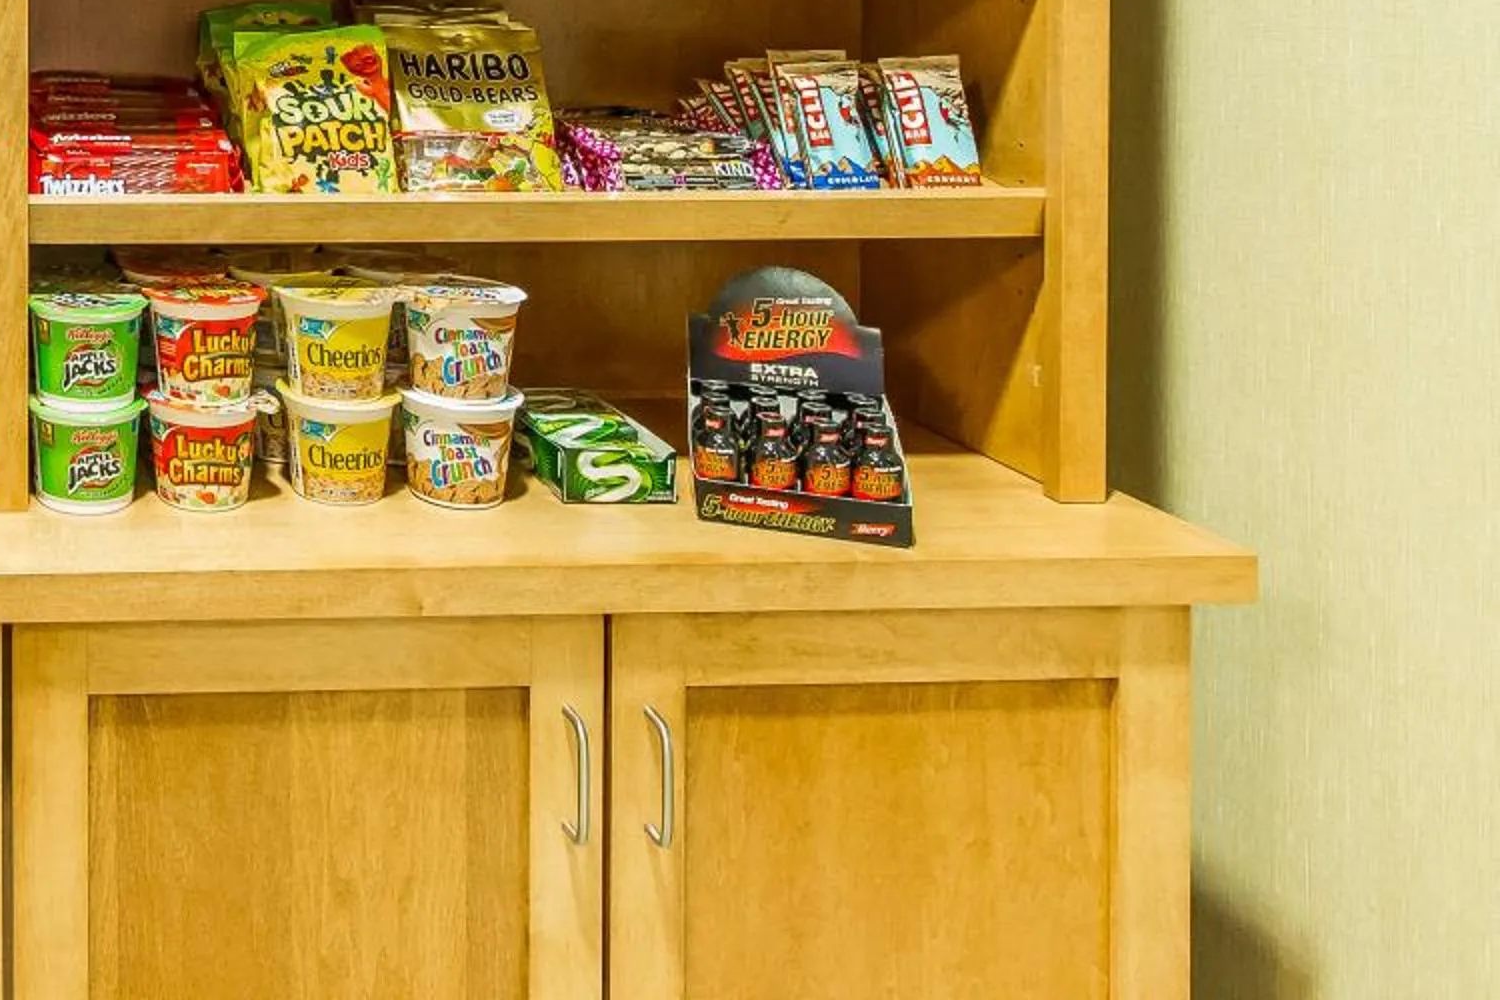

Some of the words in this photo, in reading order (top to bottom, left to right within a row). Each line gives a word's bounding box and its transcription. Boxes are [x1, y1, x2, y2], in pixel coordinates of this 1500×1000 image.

[400, 53, 530, 81] HARIBO
[408, 83, 539, 104] GOLD-BEARS
[279, 93, 378, 124] SOUR
[281, 121, 386, 155] PATCH
[329, 151, 370, 168] Kids
[712, 161, 754, 177] KIND
[752, 299, 834, 328] 5-hour
[194, 330, 251, 355] Lucky
[452, 340, 491, 356] Toast
[744, 329, 832, 349] ENERGY
[184, 355, 250, 380] Charms
[307, 342, 381, 369] Cheerios
[63, 359, 116, 391] JACKS
[442, 352, 502, 386] Crunch
[750, 364, 818, 378] EXTRA
[751, 375, 819, 387] STRENGTH
[177, 435, 235, 461] Lucky
[309, 444, 383, 471] Cheerios
[440, 445, 478, 459] Toast
[68, 460, 121, 494] JACKS
[169, 459, 242, 484] Charms
[430, 457, 492, 488] Crunch
[729, 493, 755, 504] Great
